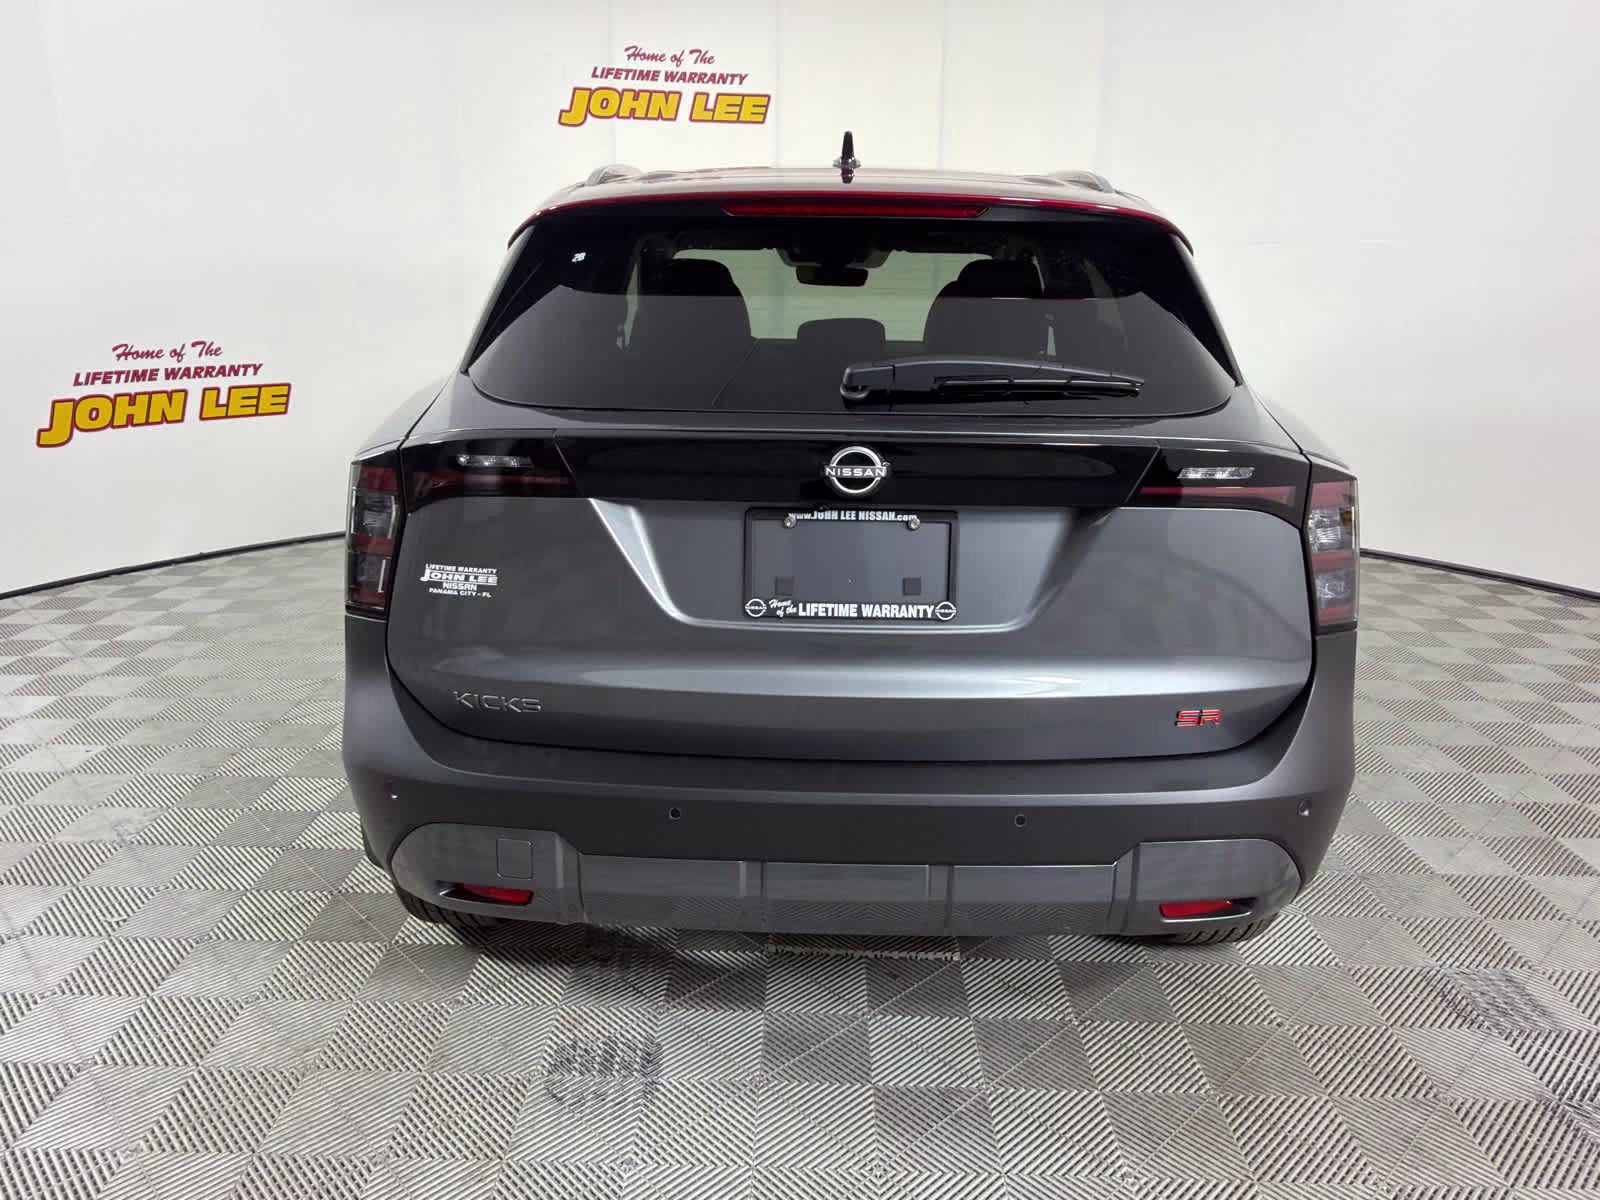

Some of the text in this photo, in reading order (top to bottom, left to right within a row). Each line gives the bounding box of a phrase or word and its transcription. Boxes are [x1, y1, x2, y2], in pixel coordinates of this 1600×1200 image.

[624, 45, 715, 67] Home of The
[591, 66, 748, 85] LIFETIME WARRANTY
[558, 86, 771, 127] JOHN LEE
[112, 340, 223, 363] Home of The
[73, 363, 263, 387] LIFETIME WARRANTY
[36, 383, 291, 448] JOHN LEE
[825, 467, 886, 477] NISSAN
[840, 510, 856, 520] LEE
[420, 568, 498, 584] JOHN LEE
[425, 563, 497, 574] LIFETIME WARRANTY
[429, 587, 458, 595] PANAMA
[442, 581, 477, 591] NISSAN
[798, 603, 935, 618] LIFETIME WARRANTY
[453, 691, 541, 712] KICKS
[1175, 708, 1222, 726] SR
